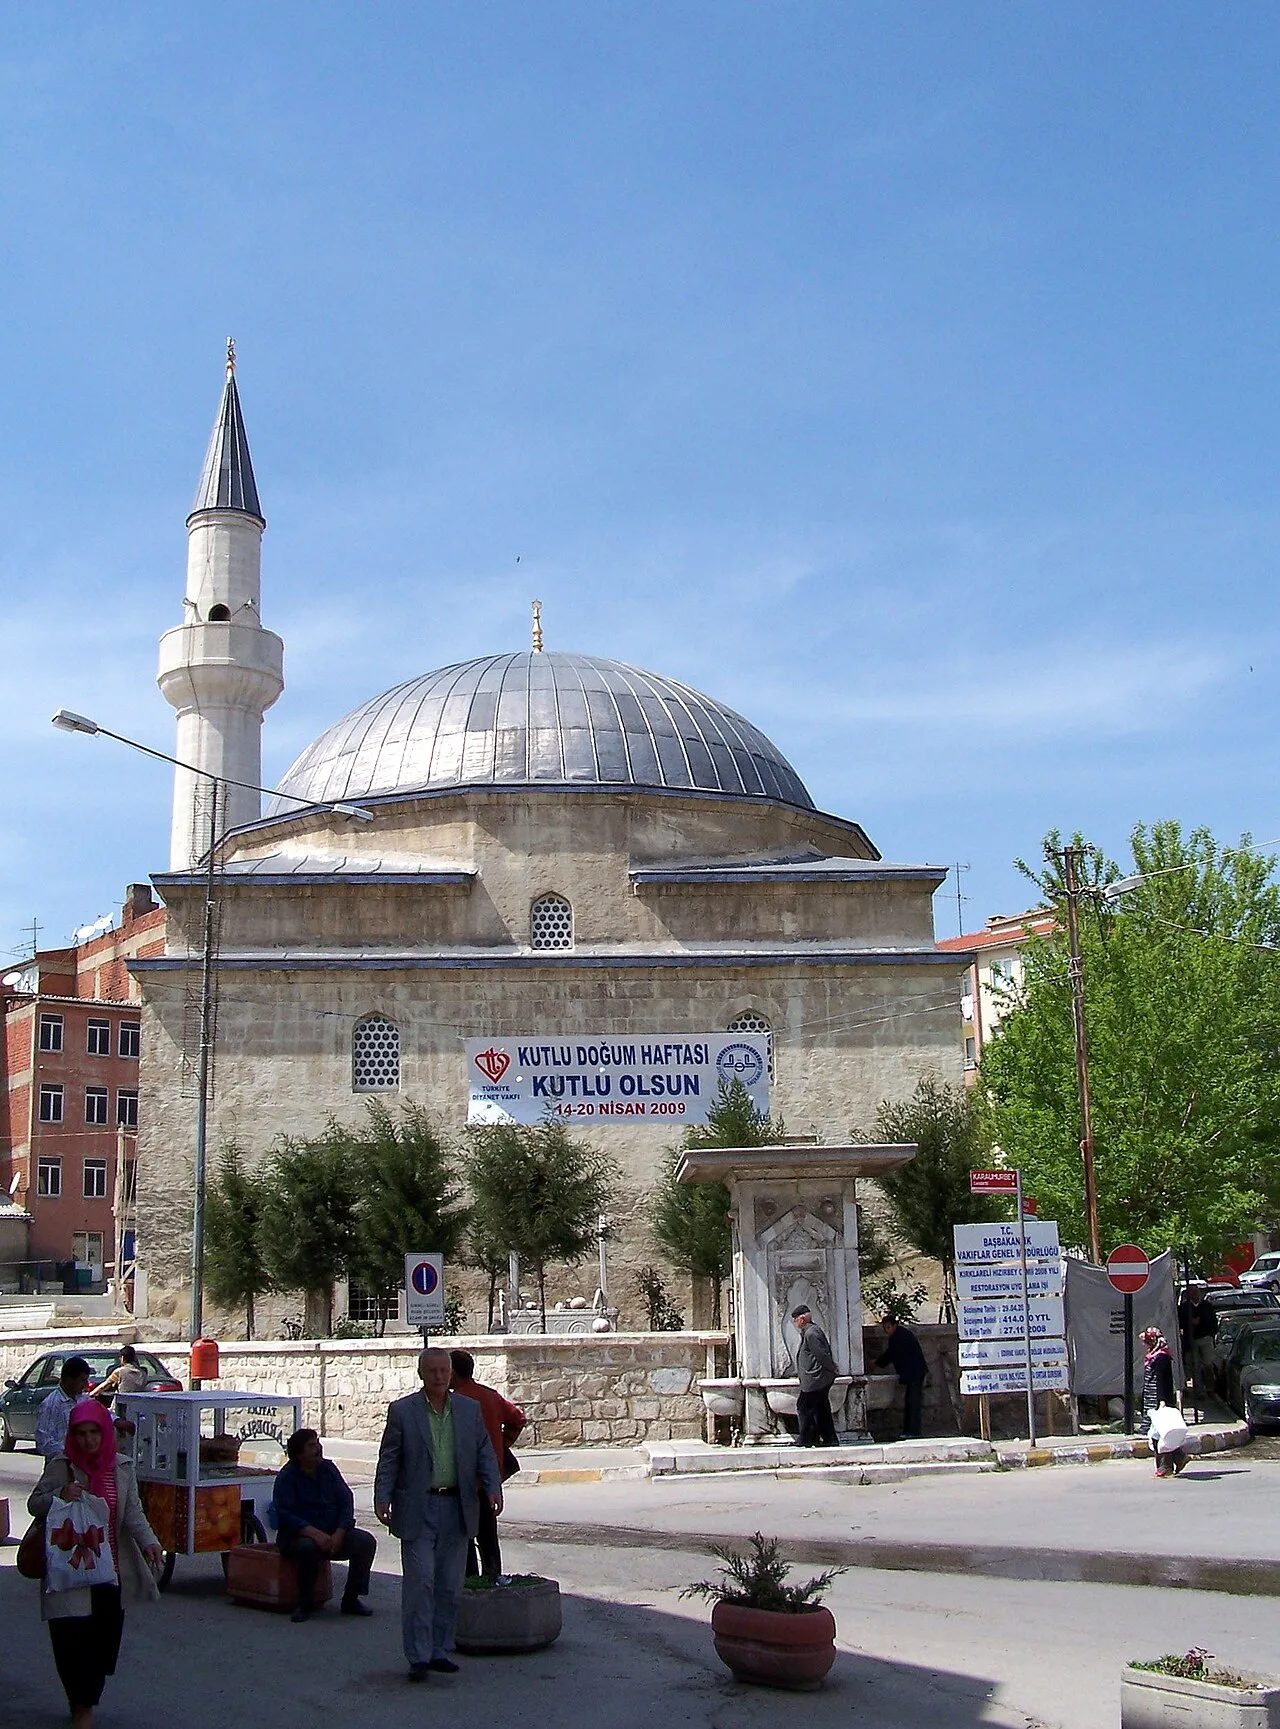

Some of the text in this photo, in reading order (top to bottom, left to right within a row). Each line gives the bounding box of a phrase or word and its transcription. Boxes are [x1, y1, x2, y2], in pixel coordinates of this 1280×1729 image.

[518, 1041, 709, 1067] KUTLU DOĞUM HAFTASI
[532, 1075, 611, 1097] KUTLU
[618, 1074, 700, 1096] OLSUN
[556, 1100, 686, 1115] 14-20 NİSAN 2009
[1000, 1226, 1013, 1235] T.C.
[983, 1236, 1032, 1248] BAŞBAKANIK
[957, 1249, 991, 1260] VAKIFLAR
[992, 1248, 1015, 1258] GENEL
[970, 1283, 1010, 1292] RESTORASYON
[1010, 1282, 1040, 1290] UYGLAMA
